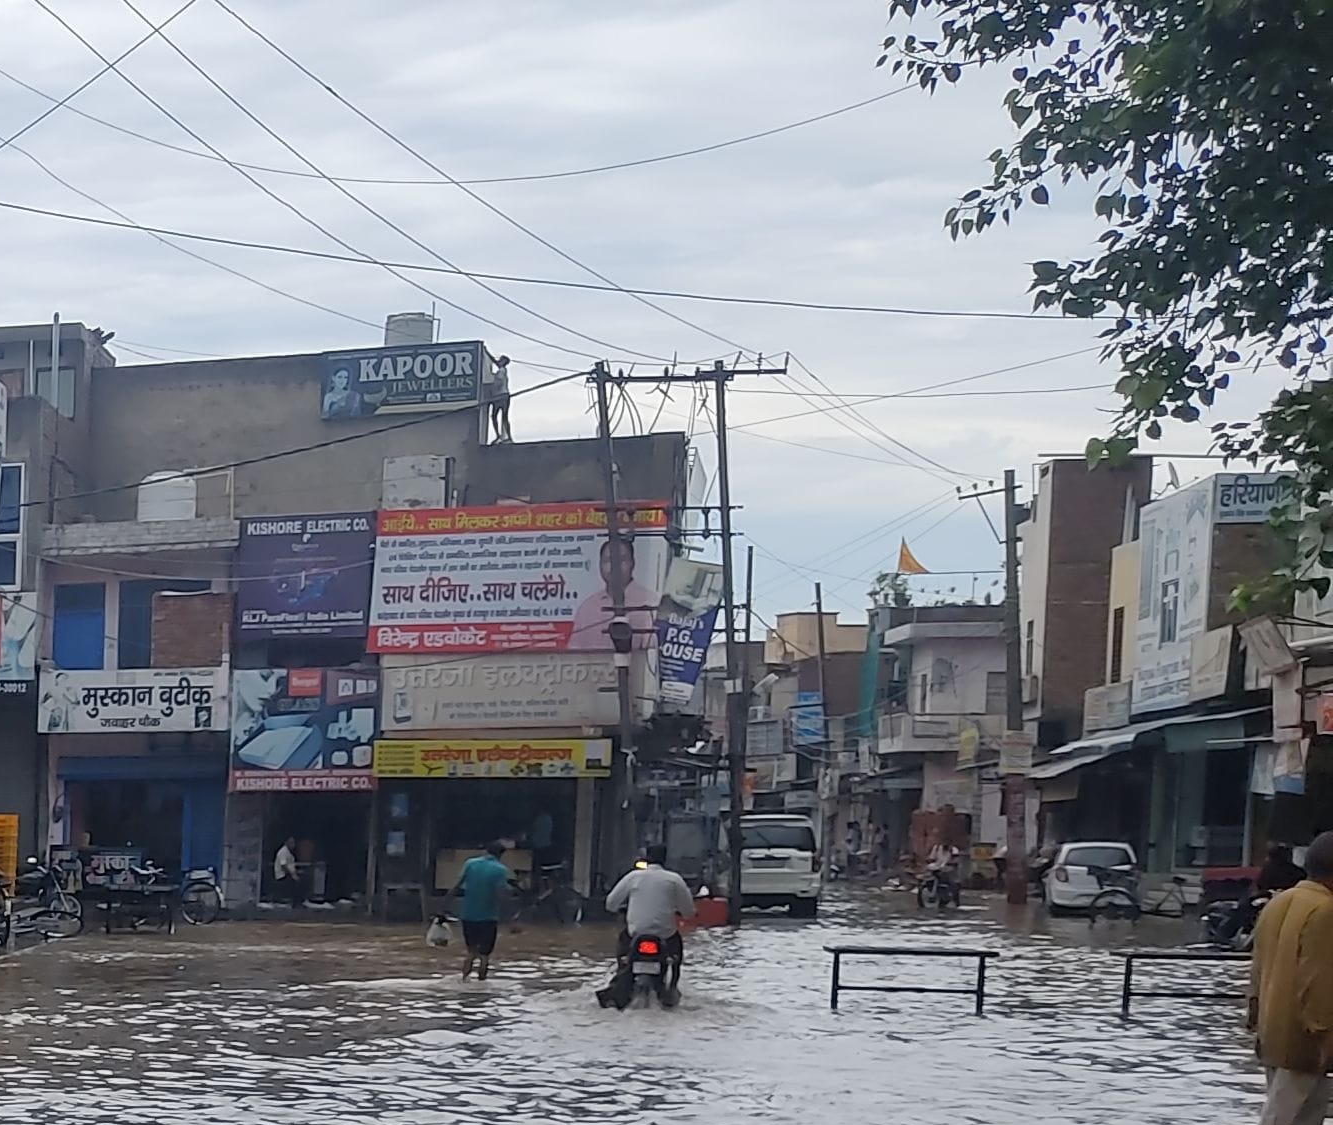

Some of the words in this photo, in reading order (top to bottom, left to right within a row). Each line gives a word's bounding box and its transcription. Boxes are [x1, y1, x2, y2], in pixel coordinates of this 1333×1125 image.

[359, 352, 474, 382] KAPOOR
[390, 378, 474, 394] JEWELLERS
[247, 520, 303, 536] KISHORE
[306, 518, 352, 534] ELECTRIC
[352, 517, 370, 531] CO.
[381, 584, 416, 605] साथ
[665, 627, 695, 646] P.G.
[660, 642, 705, 663] OUSE
[81, 685, 155, 719] मुस्कान
[235, 777, 289, 790] KISHORE
[291, 776, 349, 789] ELECTRIC
[351, 776, 372, 789] CO.
